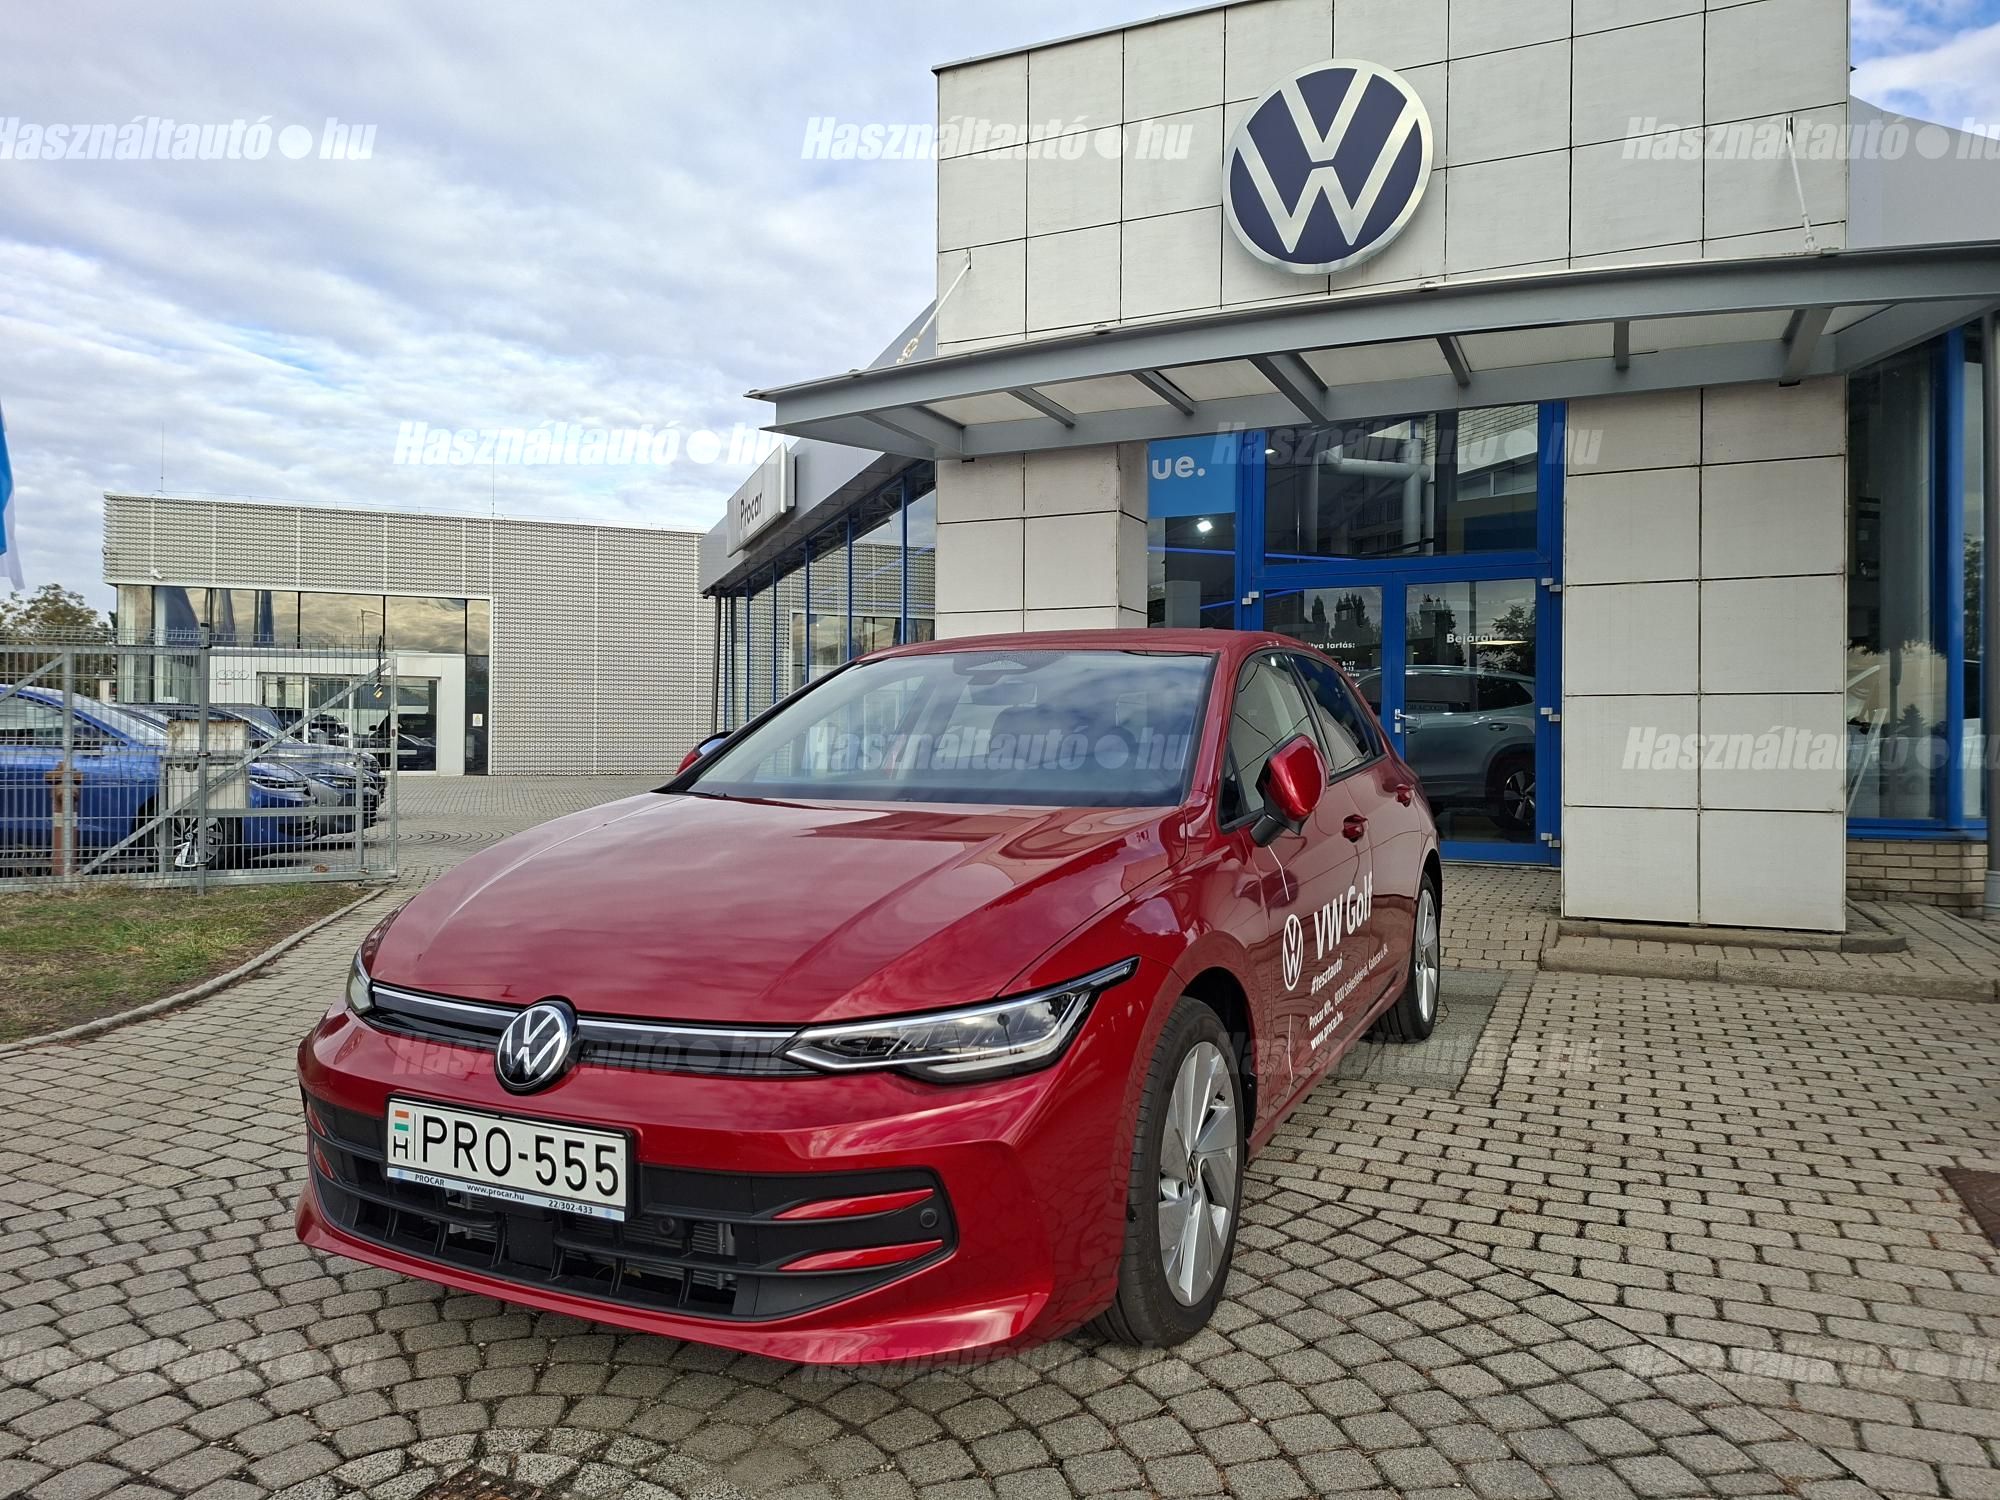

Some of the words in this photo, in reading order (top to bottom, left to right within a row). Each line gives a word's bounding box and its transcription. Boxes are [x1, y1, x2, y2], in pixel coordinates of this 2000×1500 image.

[740, 492, 763, 531] Procar
[1314, 893, 1343, 960] VW
[1346, 871, 1373, 935] Golf
[1309, 1009, 1324, 1031] Procar
[1310, 1010, 1344, 1051] www.procar.hu
[393, 1136, 408, 1160] H
[422, 1114, 619, 1197] PRO-555
[414, 1173, 445, 1187] PROCAR
[466, 1183, 525, 1201] www.procar.hu
[548, 1199, 593, 1215] 22/302-433
